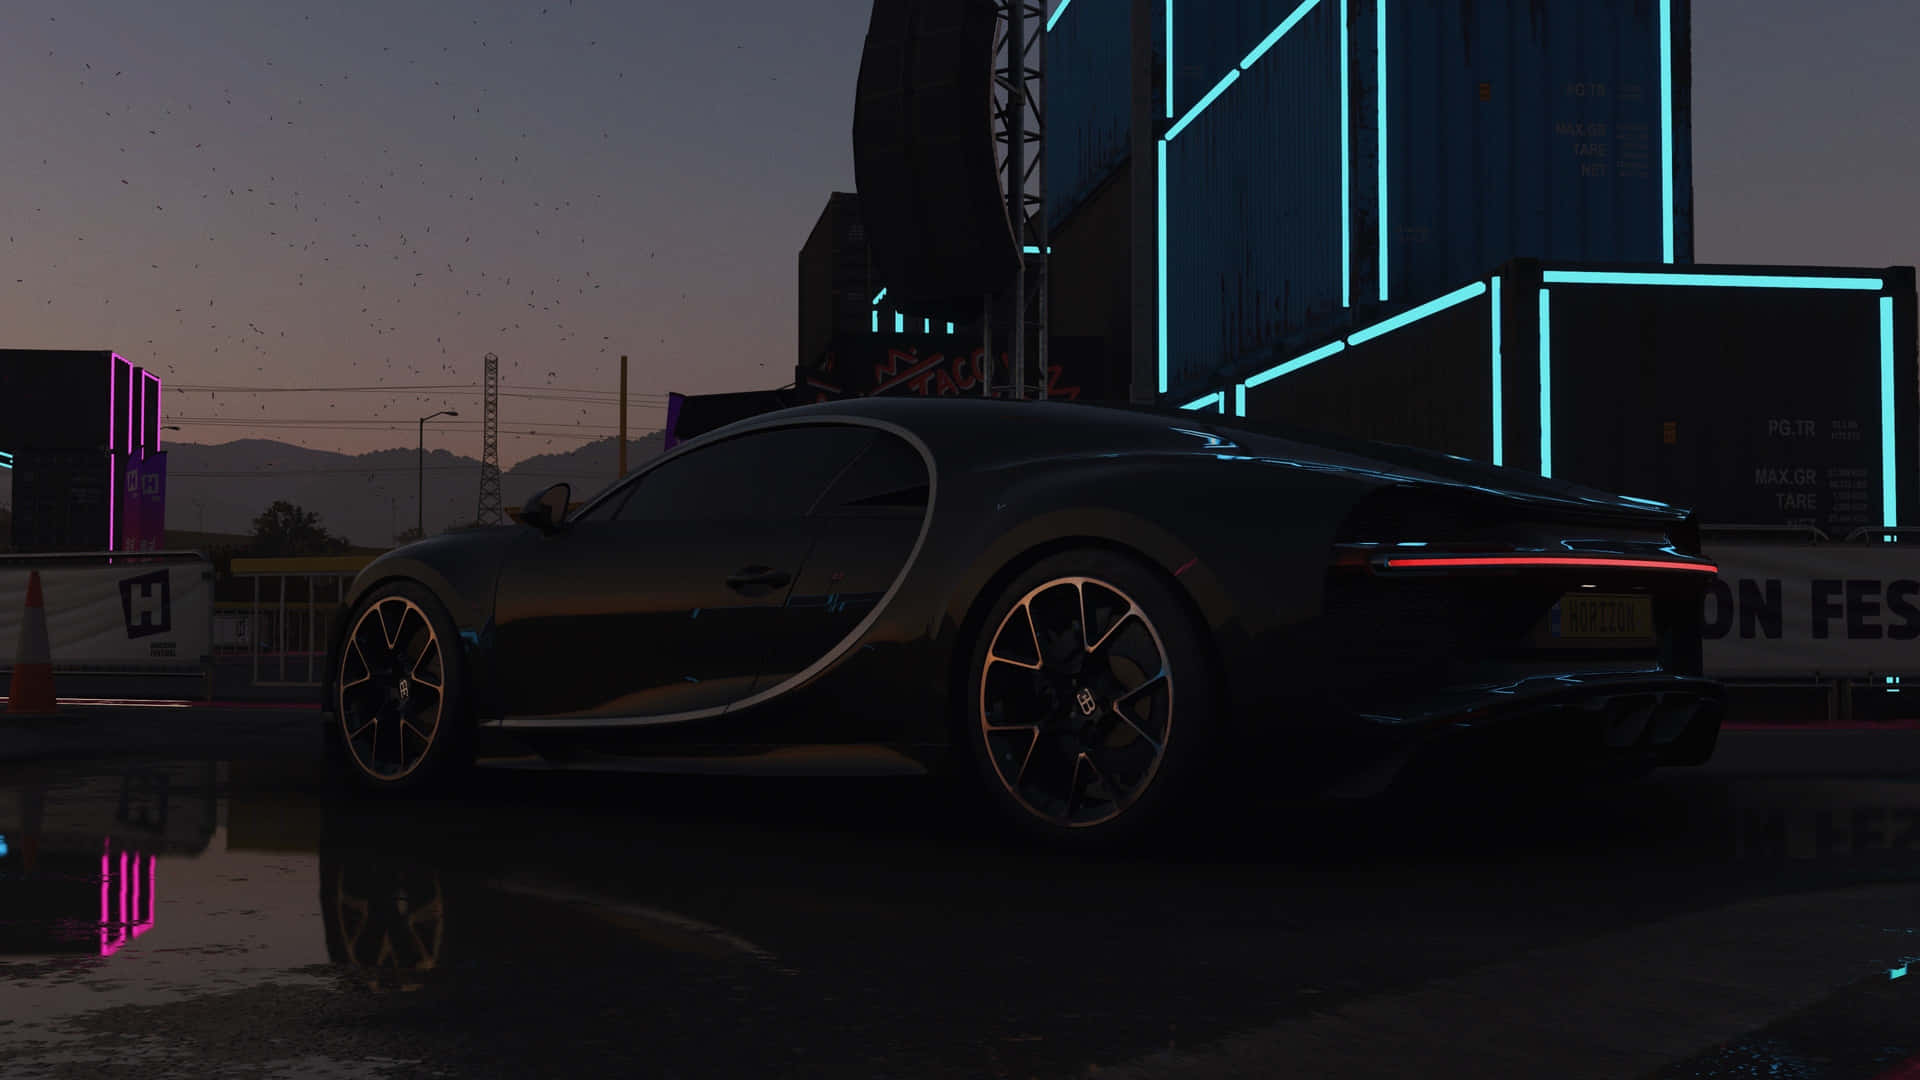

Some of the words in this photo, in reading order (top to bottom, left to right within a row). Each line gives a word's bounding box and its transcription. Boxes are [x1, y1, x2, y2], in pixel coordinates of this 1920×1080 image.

[1767, 419, 1816, 437] PG.TR
[1754, 468, 1816, 486] MAX.GR
[1775, 493, 1816, 510] TARE
[1811, 579, 1920, 639] FES
